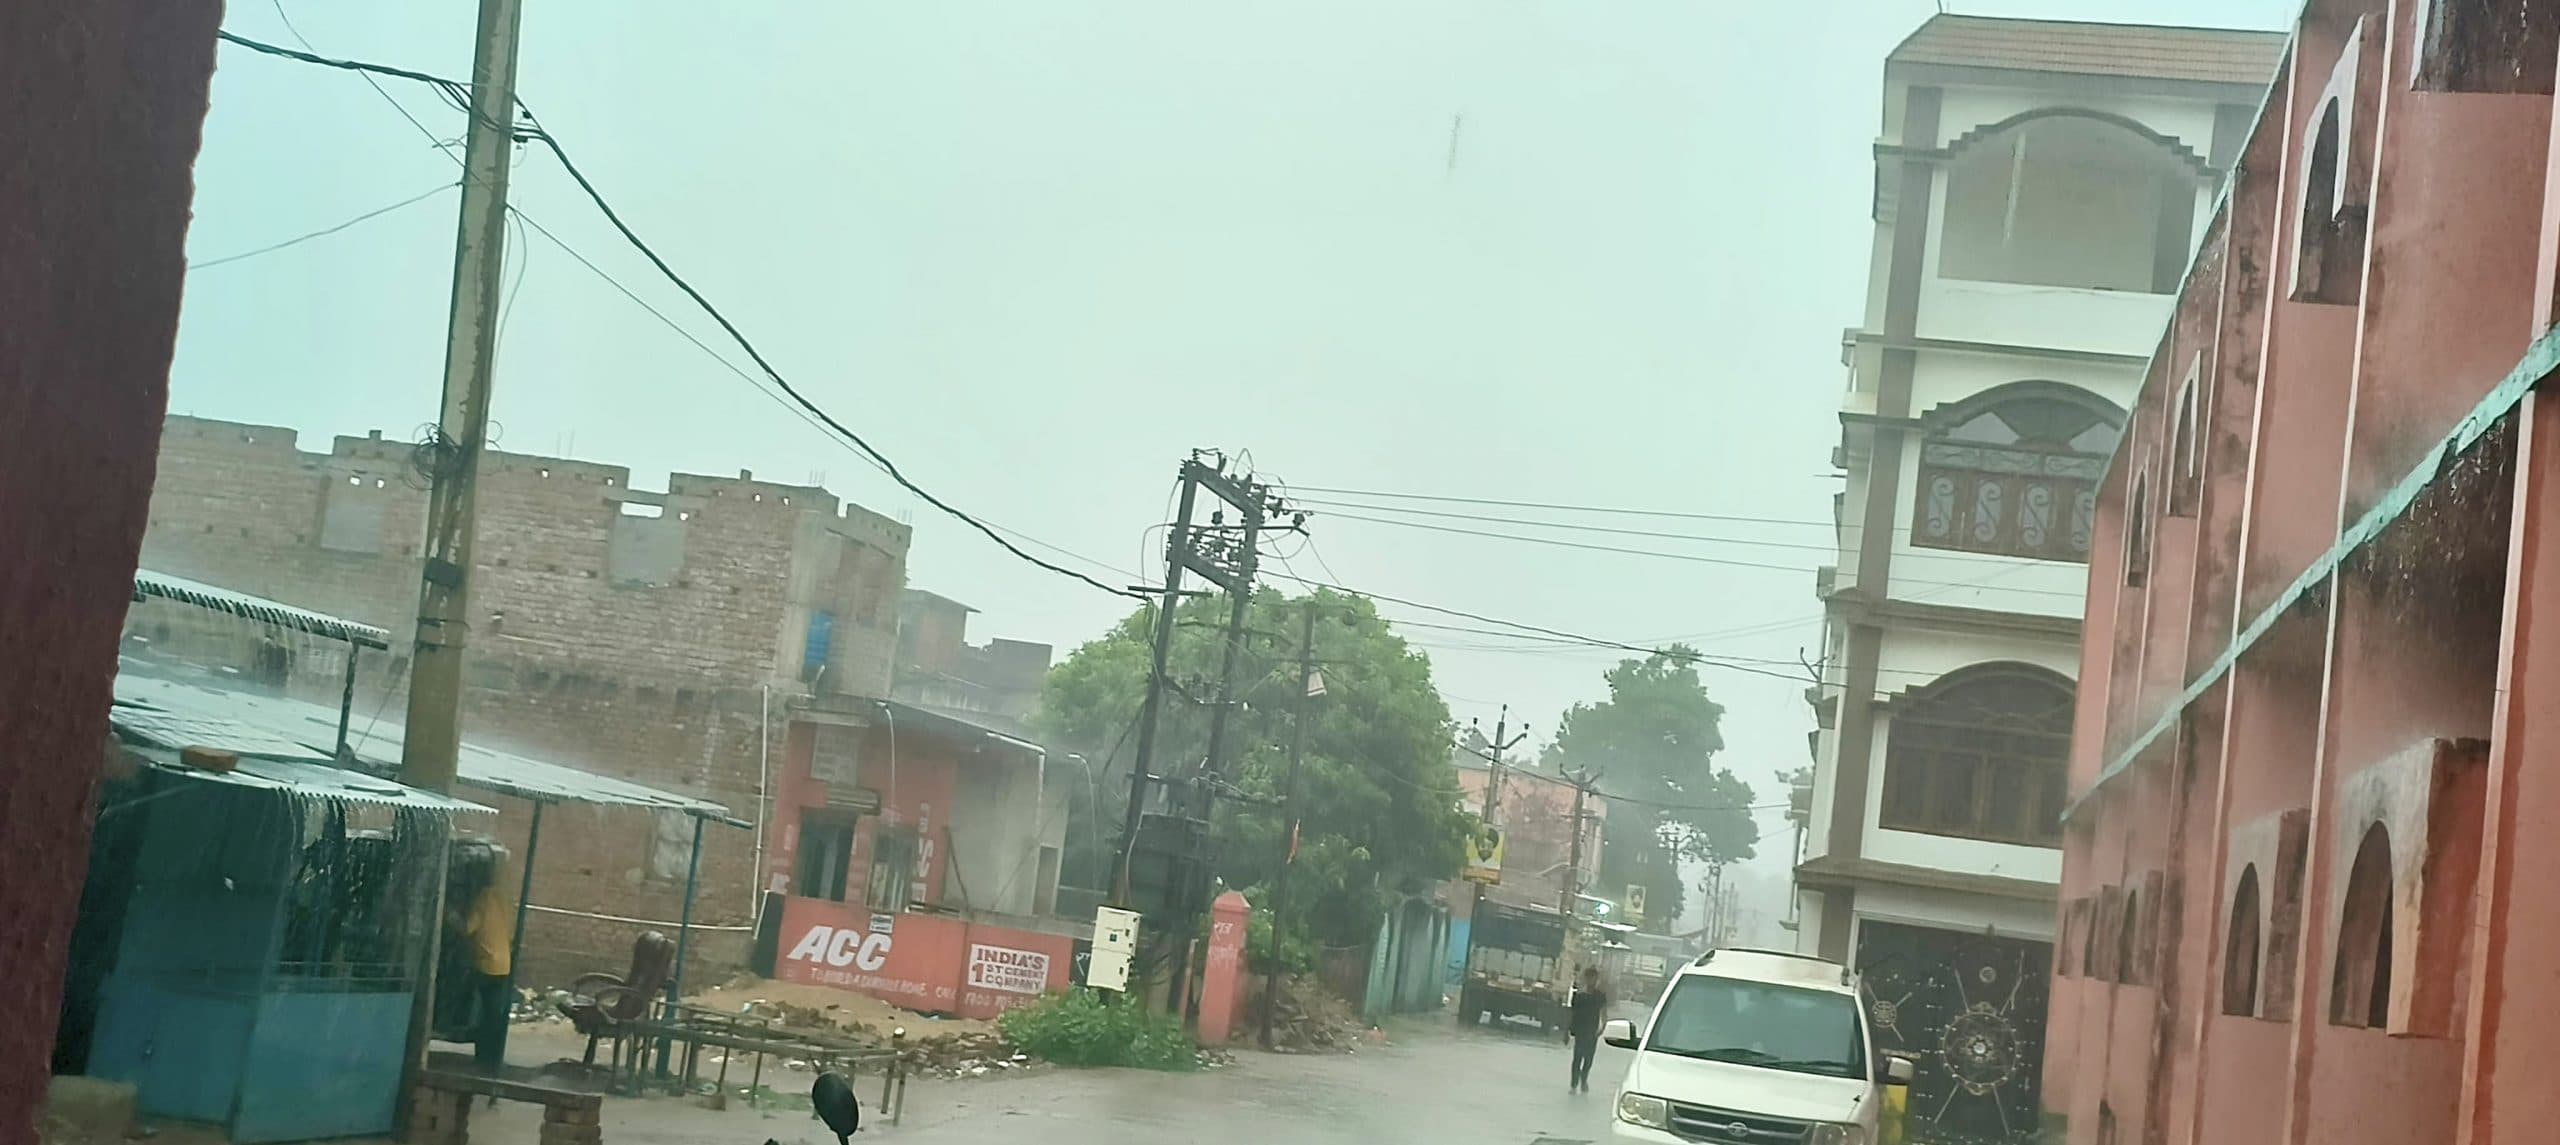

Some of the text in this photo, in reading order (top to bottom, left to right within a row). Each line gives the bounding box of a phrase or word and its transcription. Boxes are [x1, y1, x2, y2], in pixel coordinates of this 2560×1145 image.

[786, 925, 892, 971] ACC
[976, 948, 1045, 970] INDIA'S
[972, 963, 984, 983] 1
[985, 974, 1041, 991] COMPANY
